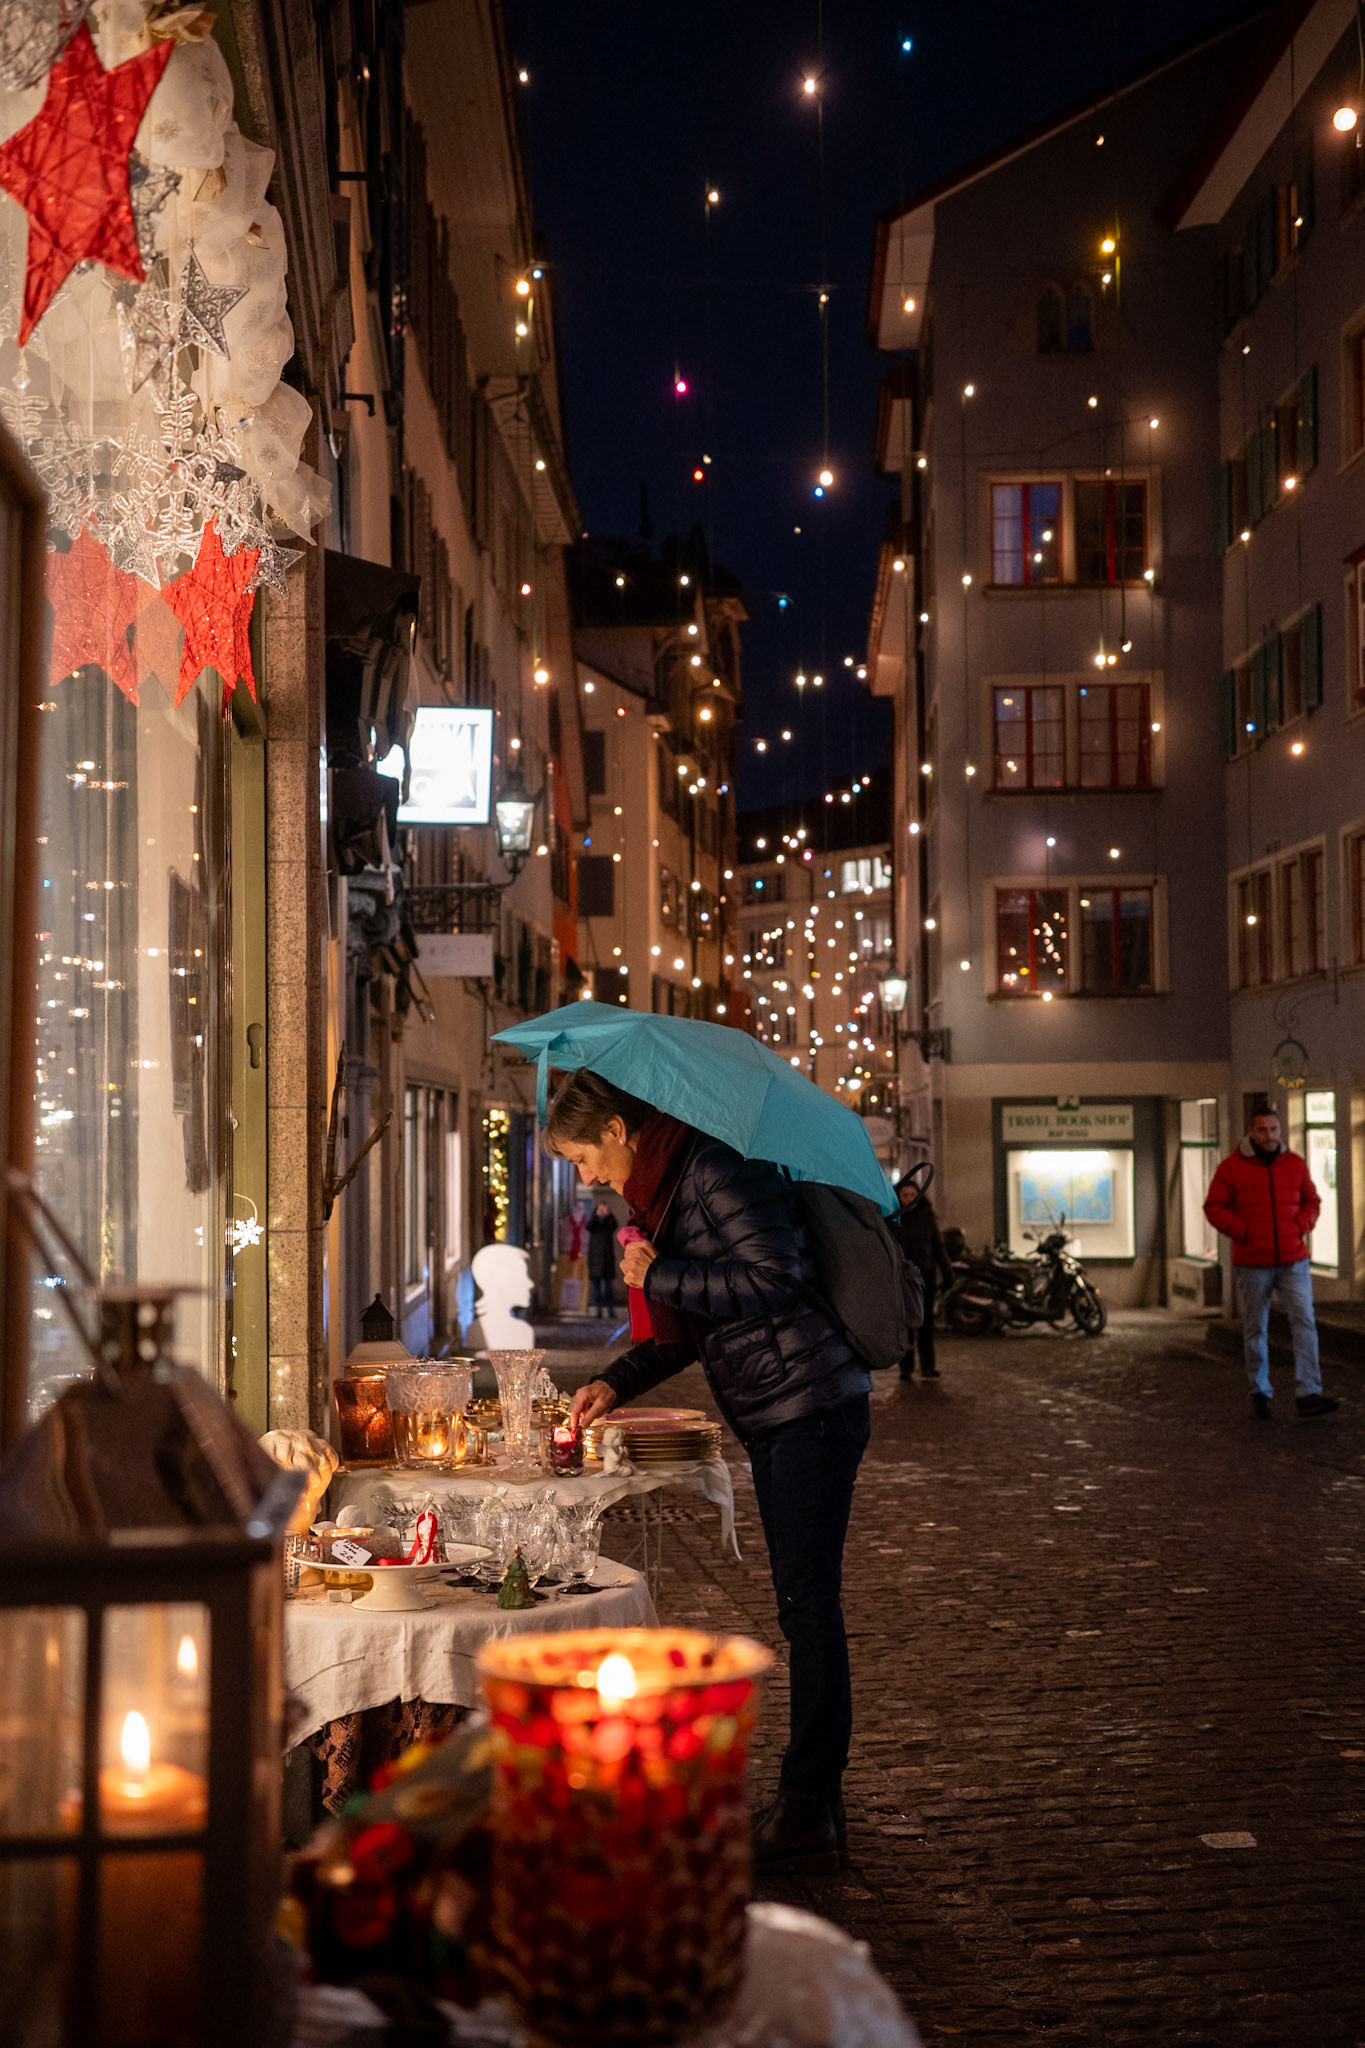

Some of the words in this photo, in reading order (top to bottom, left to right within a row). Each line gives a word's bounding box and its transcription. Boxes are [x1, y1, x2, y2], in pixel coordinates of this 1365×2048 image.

[1008, 1115, 1049, 1127] TRAVEL
[1056, 1115, 1092, 1126] BOOK
[1095, 1114, 1130, 1126] SHOP
